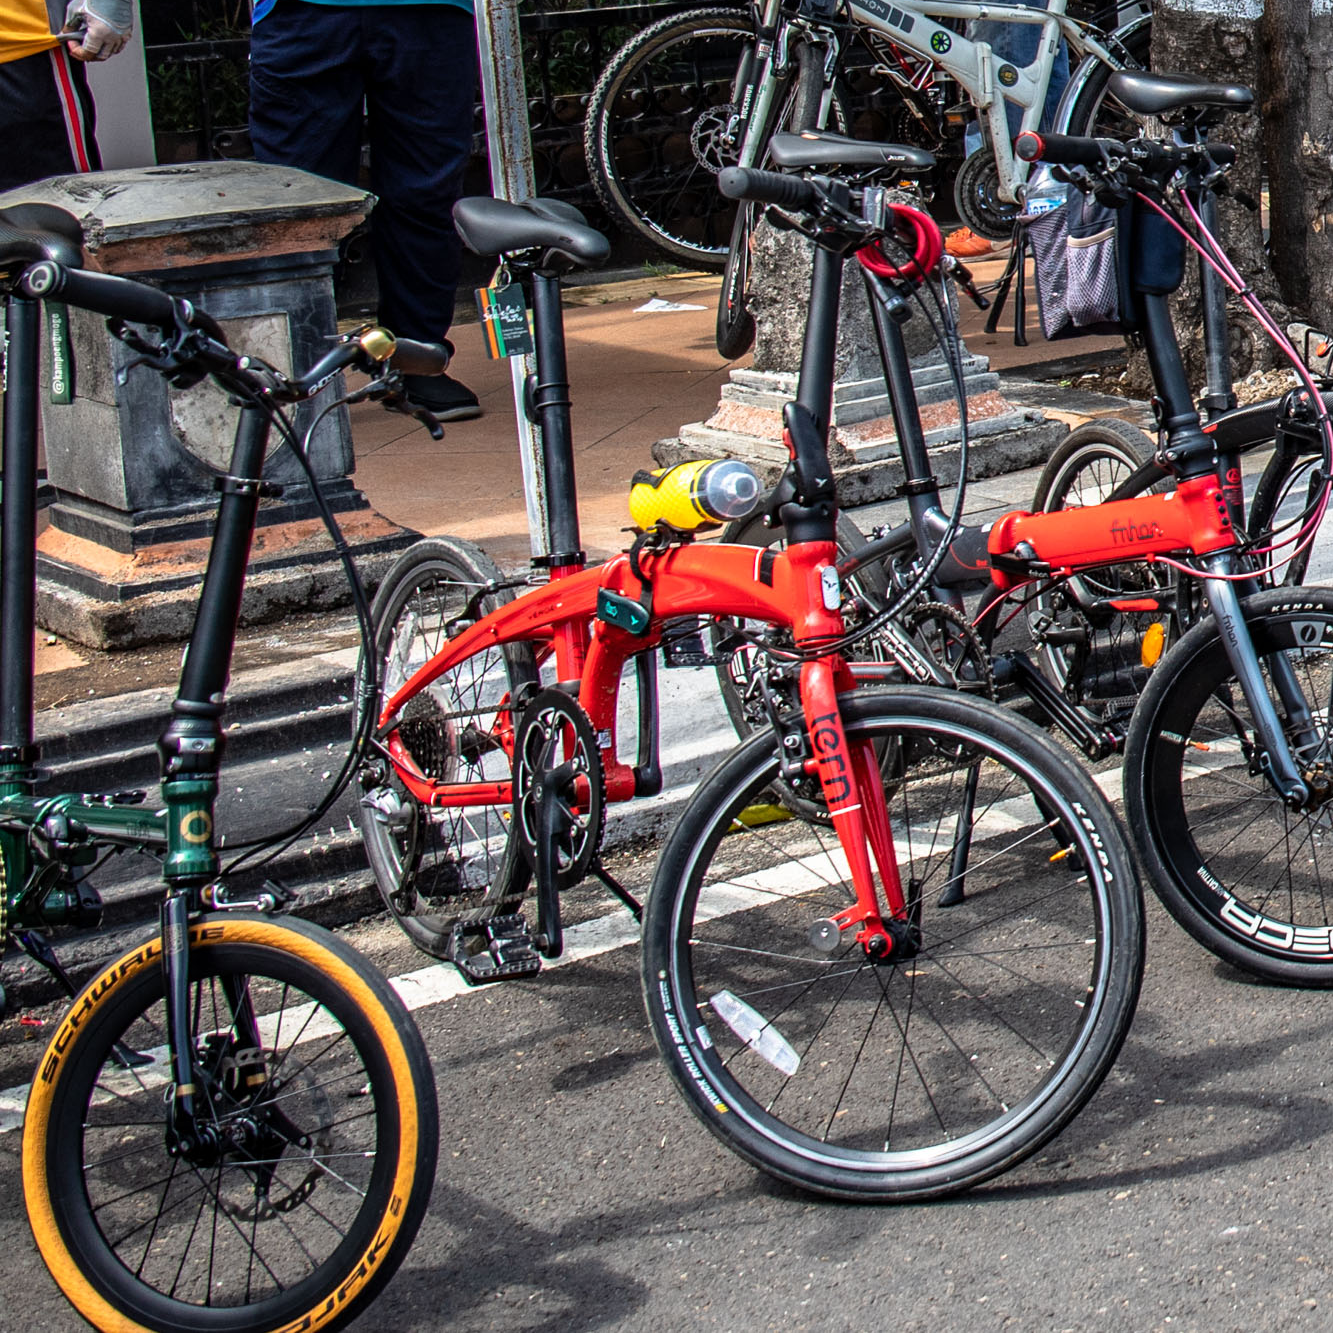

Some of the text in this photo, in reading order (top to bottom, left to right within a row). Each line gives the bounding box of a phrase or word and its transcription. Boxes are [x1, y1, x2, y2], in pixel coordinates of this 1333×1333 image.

[740, 84, 754, 120] ROCKSHOX
[601, 109, 615, 180] MERIDA
[1271, 603, 1324, 613] KENDA
[1222, 614, 1239, 649] fnhon
[1071, 802, 1114, 883] KENDA
[664, 1012, 685, 1045] SPORT
[677, 1045, 703, 1079] ROLLER
[695, 1078, 722, 1107] KWICK
